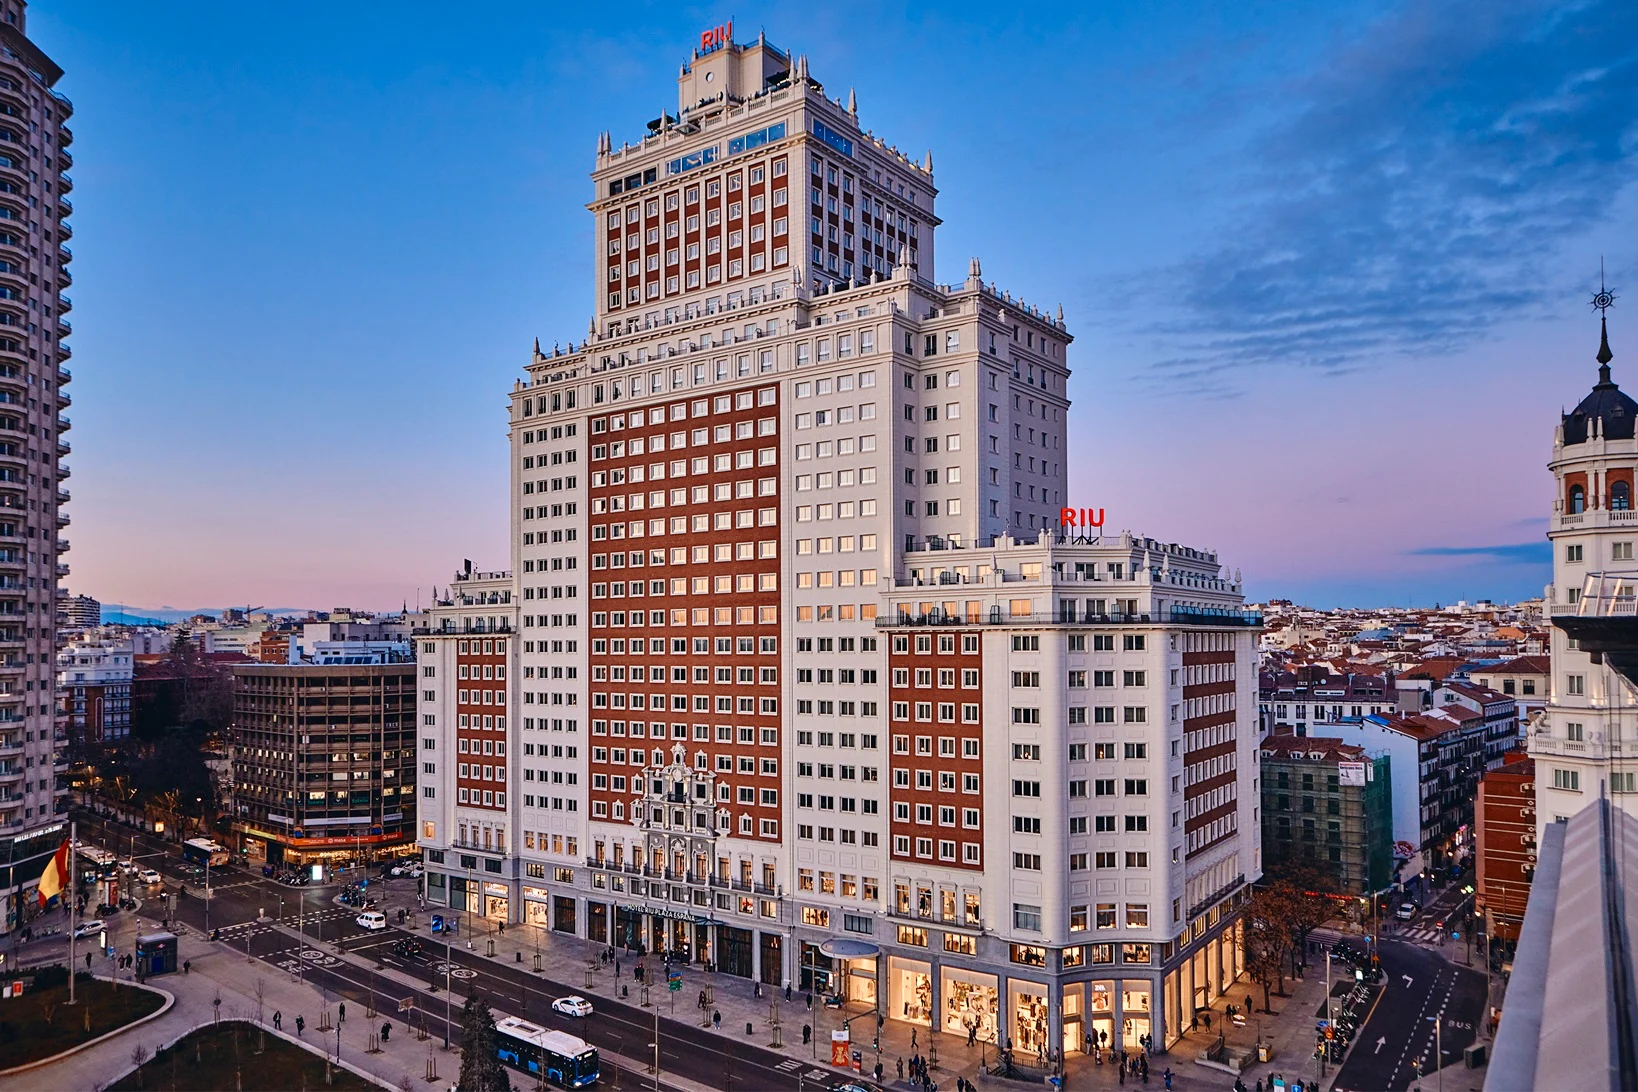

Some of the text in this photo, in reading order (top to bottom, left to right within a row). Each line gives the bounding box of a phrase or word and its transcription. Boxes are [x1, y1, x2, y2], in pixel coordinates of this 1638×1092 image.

[701, 20, 732, 51] RIU
[1061, 507, 1104, 527] RIU
[627, 903, 644, 913] HOTEL
[644, 906, 655, 915] RIU
[655, 908, 673, 918] PLAZA
[1448, 1020, 1472, 1030] BUS
